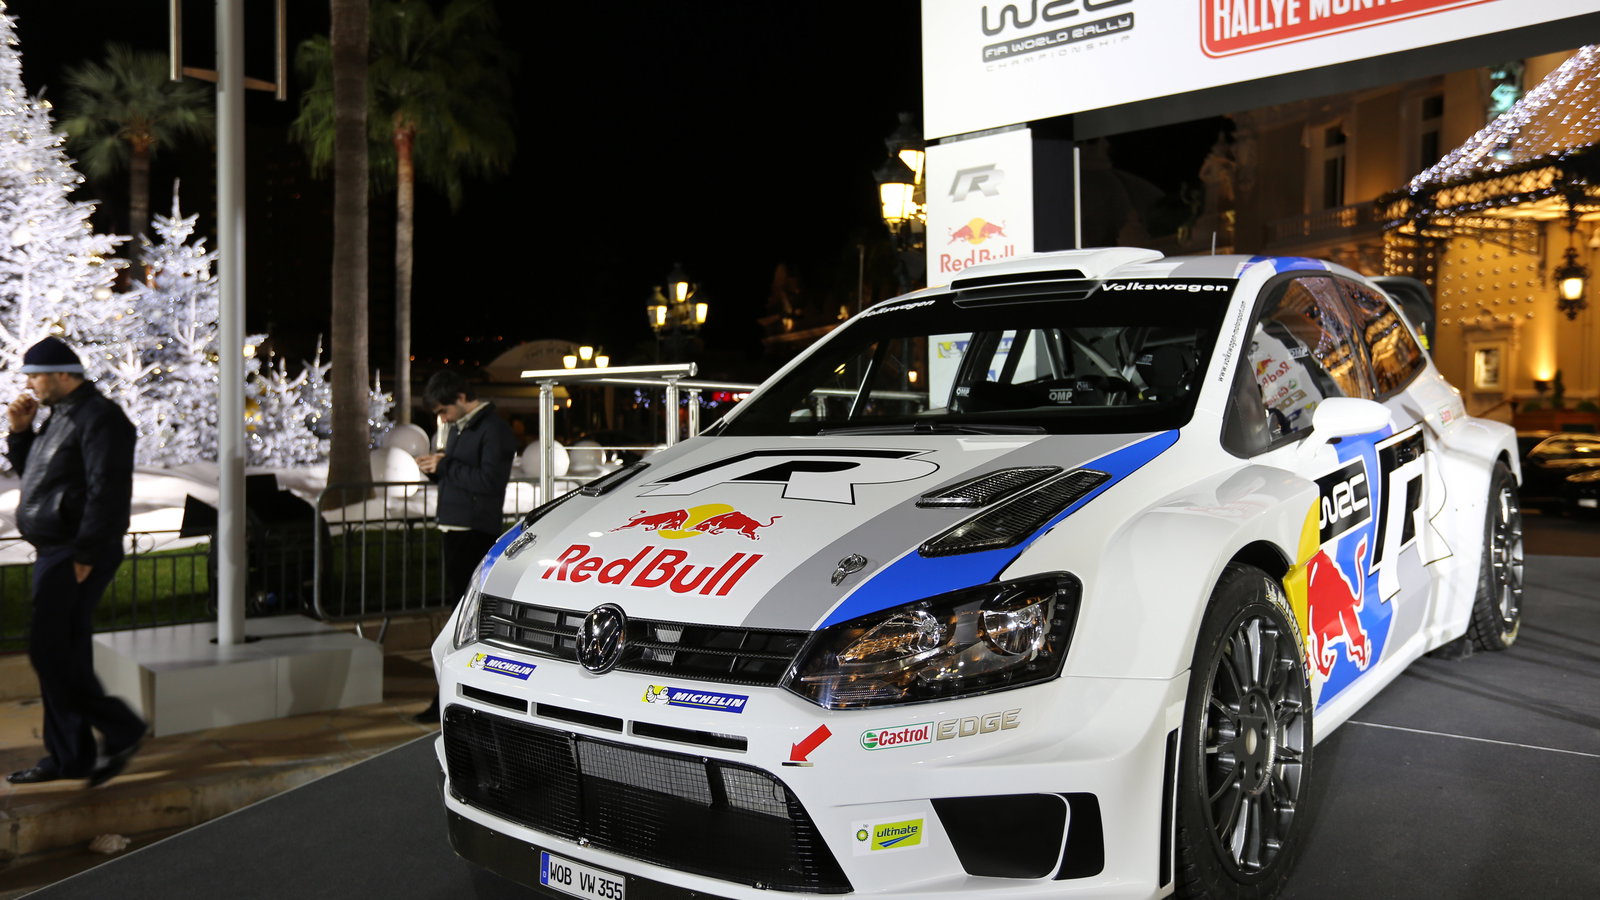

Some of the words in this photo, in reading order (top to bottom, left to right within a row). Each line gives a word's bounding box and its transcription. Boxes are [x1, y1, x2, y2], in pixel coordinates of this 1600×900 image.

[1011, 32, 1068, 53] WORLD
[1071, 16, 1131, 39] RALLY
[1213, 0, 1301, 42] RALLYE
[940, 250, 975, 273] Red
[979, 245, 1015, 263] Bll
[1101, 282, 1229, 293] Volkswagen
[1049, 390, 1073, 401] OMP
[636, 447, 939, 505] R
[542, 544, 655, 585] Red
[631, 549, 764, 597] Bull
[486, 659, 534, 675] MICHELIN
[672, 692, 746, 708] MICHELIN
[878, 726, 929, 746] Castrol
[936, 708, 1022, 741] EDGE
[876, 824, 918, 838] ultimate
[550, 861, 573, 885] WOB
[579, 871, 596, 894] VW
[597, 877, 623, 900] 355
